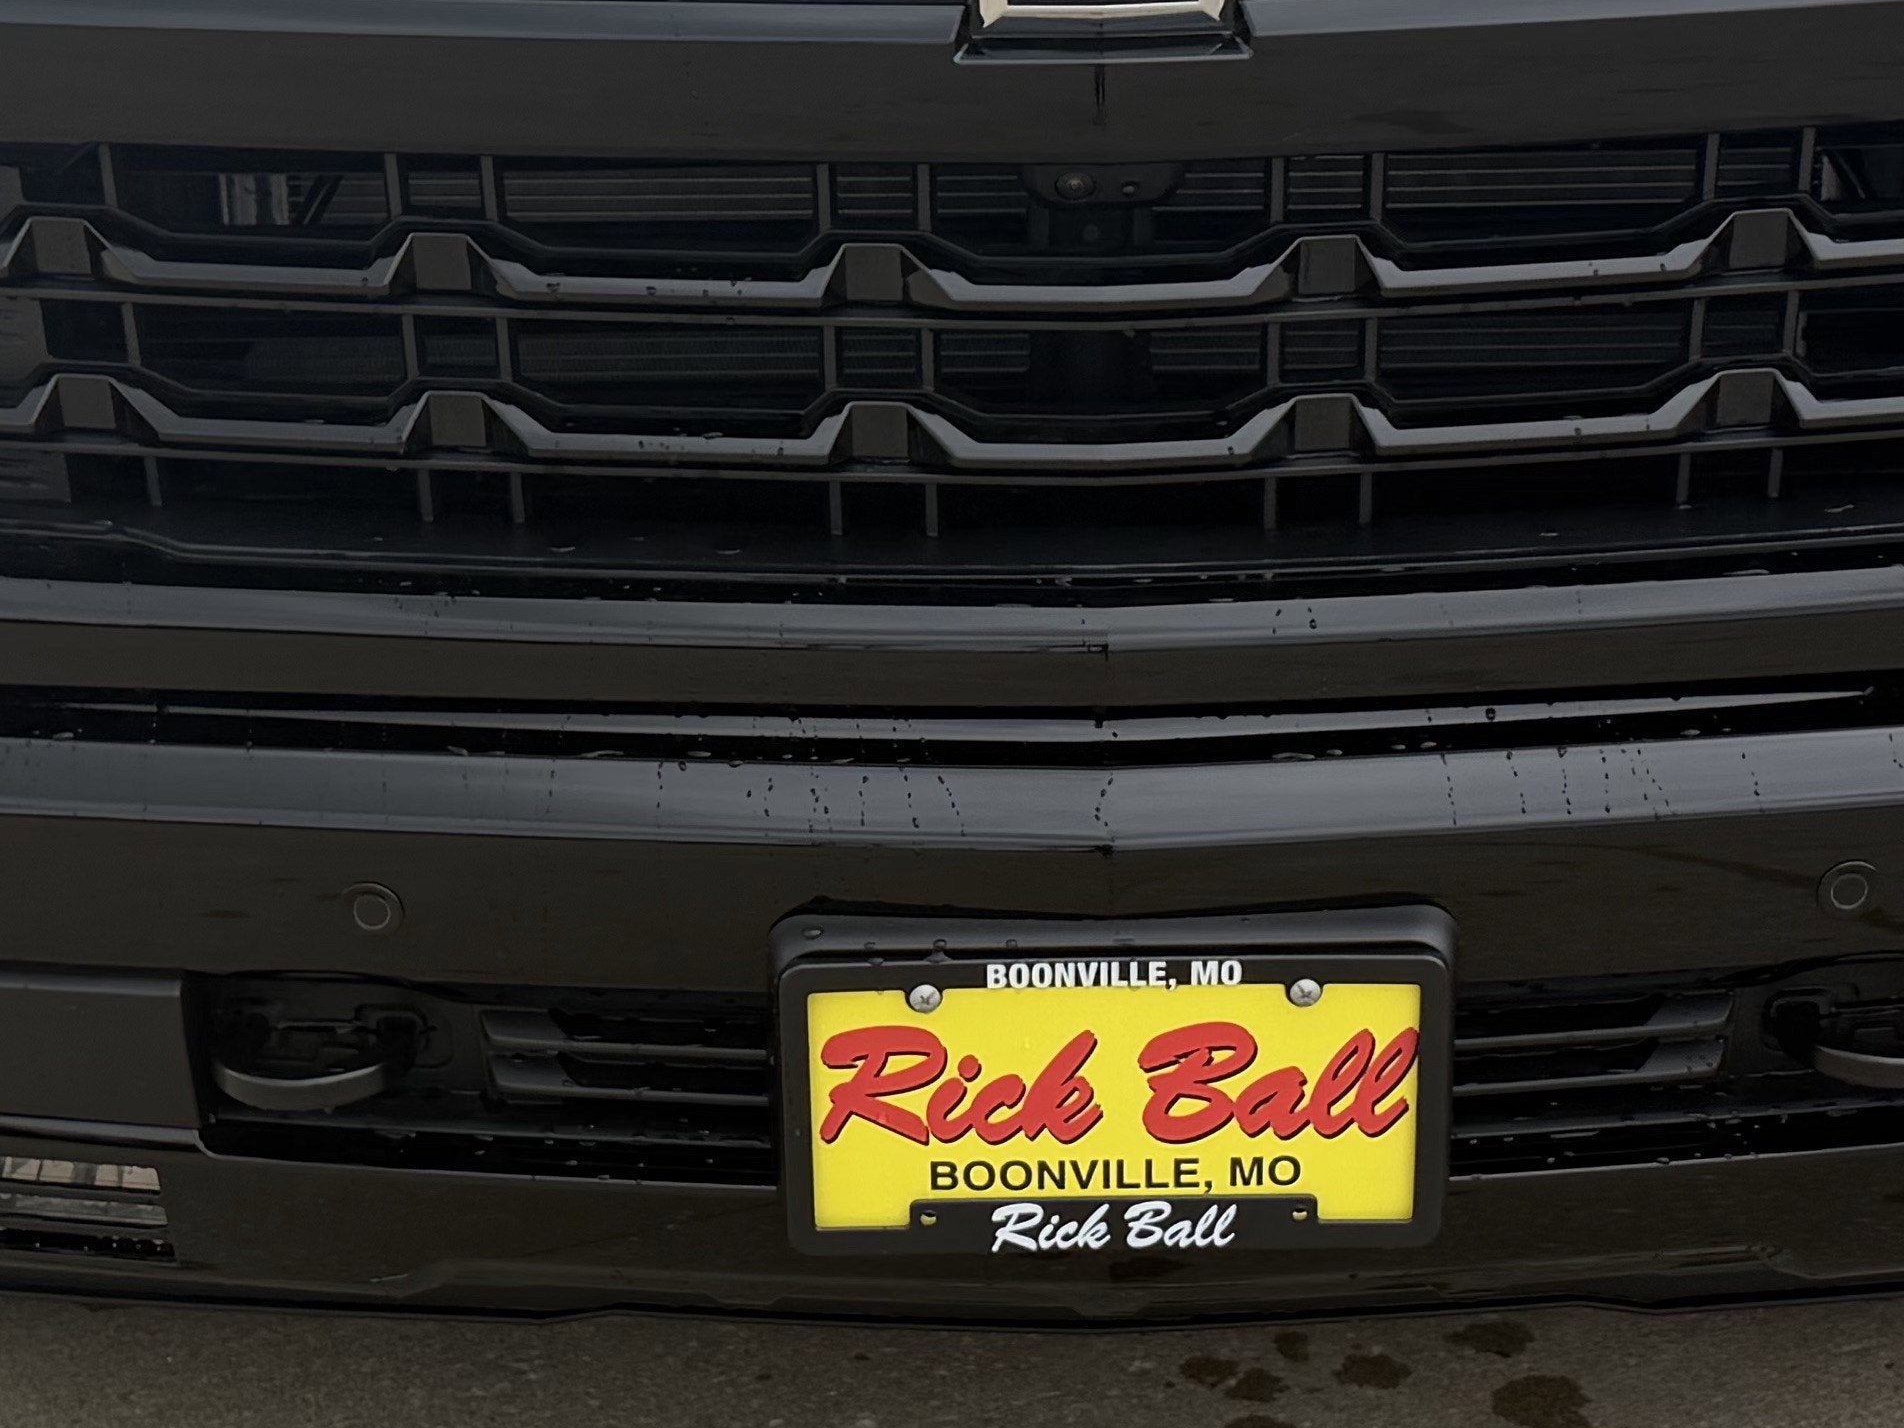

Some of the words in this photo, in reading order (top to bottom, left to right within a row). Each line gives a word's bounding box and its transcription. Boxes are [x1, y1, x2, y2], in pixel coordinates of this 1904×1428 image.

[985, 960, 1178, 990] BOONVILLE,
[1190, 959, 1243, 987] MO
[819, 1025, 1105, 1147] Rick
[1139, 1020, 1419, 1145] Ball
[930, 1156, 1213, 1195] BOONVILLE,
[1229, 1155, 1301, 1187] MO
[990, 1202, 1113, 1253] Rick
[1123, 1203, 1236, 1250] Ball
